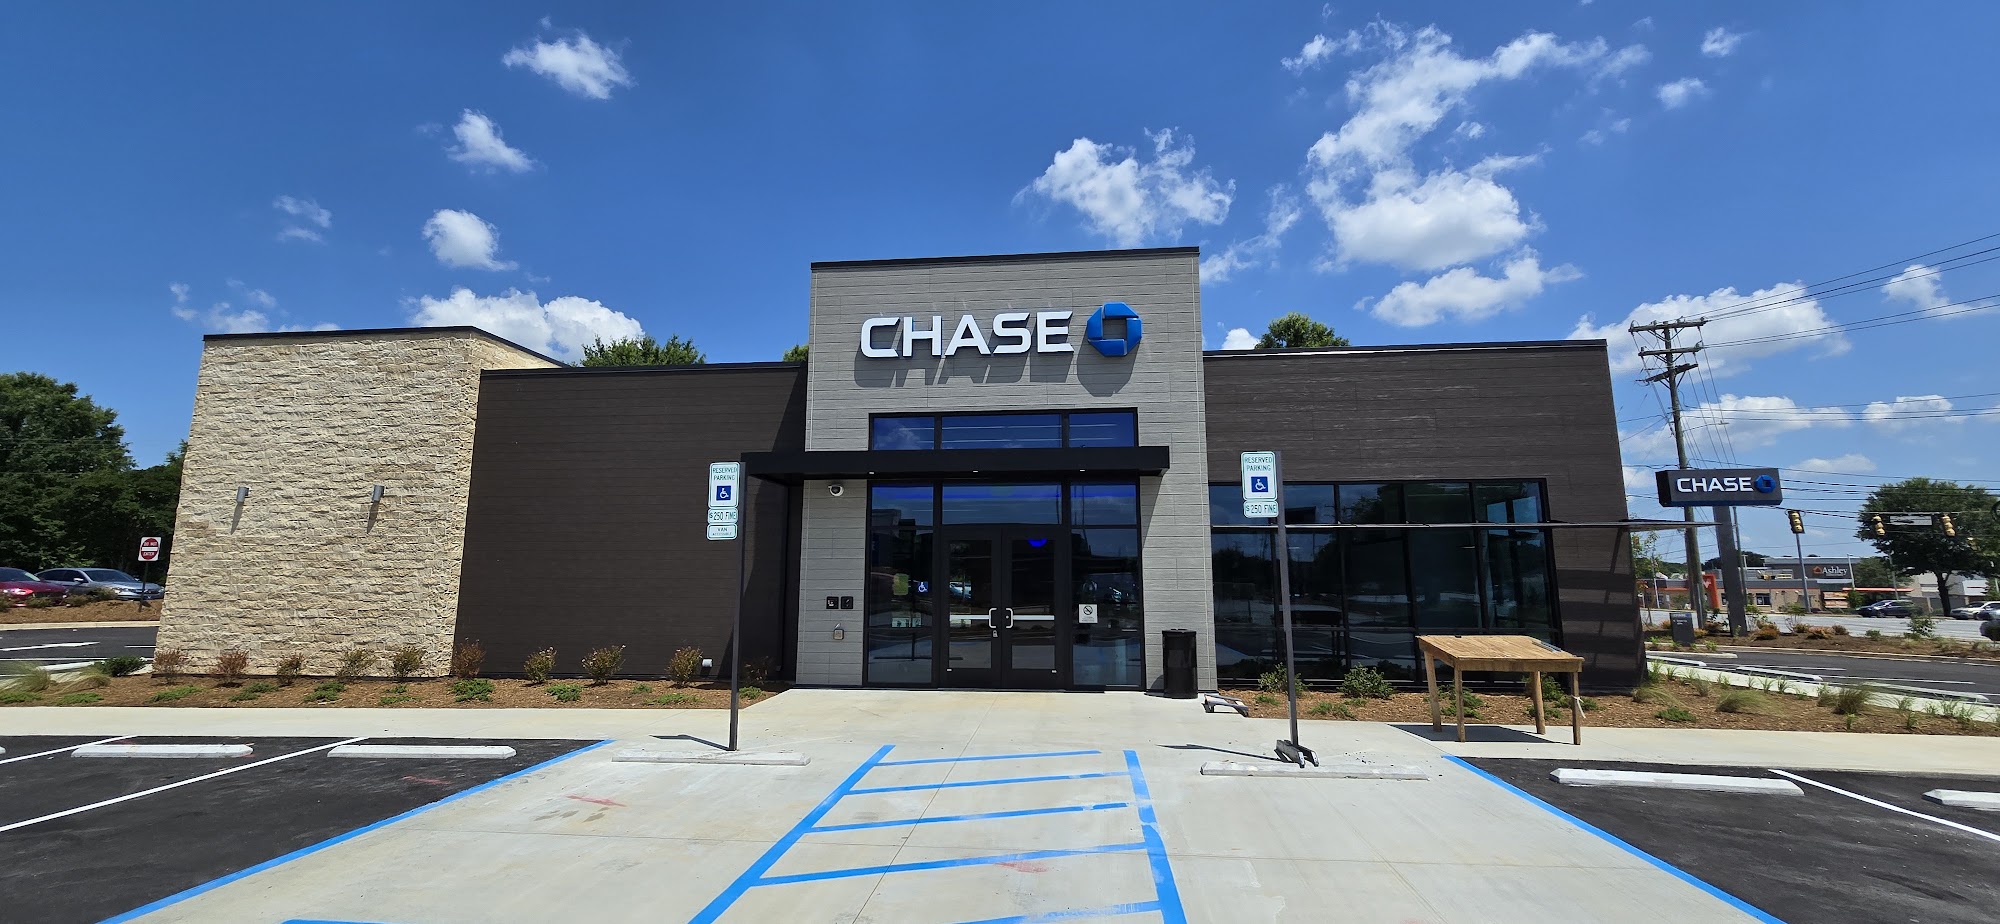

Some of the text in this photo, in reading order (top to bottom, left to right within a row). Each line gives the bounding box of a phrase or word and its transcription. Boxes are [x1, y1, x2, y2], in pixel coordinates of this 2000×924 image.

[860, 311, 1075, 358] CHASE
[1677, 477, 1754, 492] CHASE
[1264, 504, 1277, 513] FINE
[725, 511, 737, 520] FINE
[1822, 566, 1847, 576] Ashley
